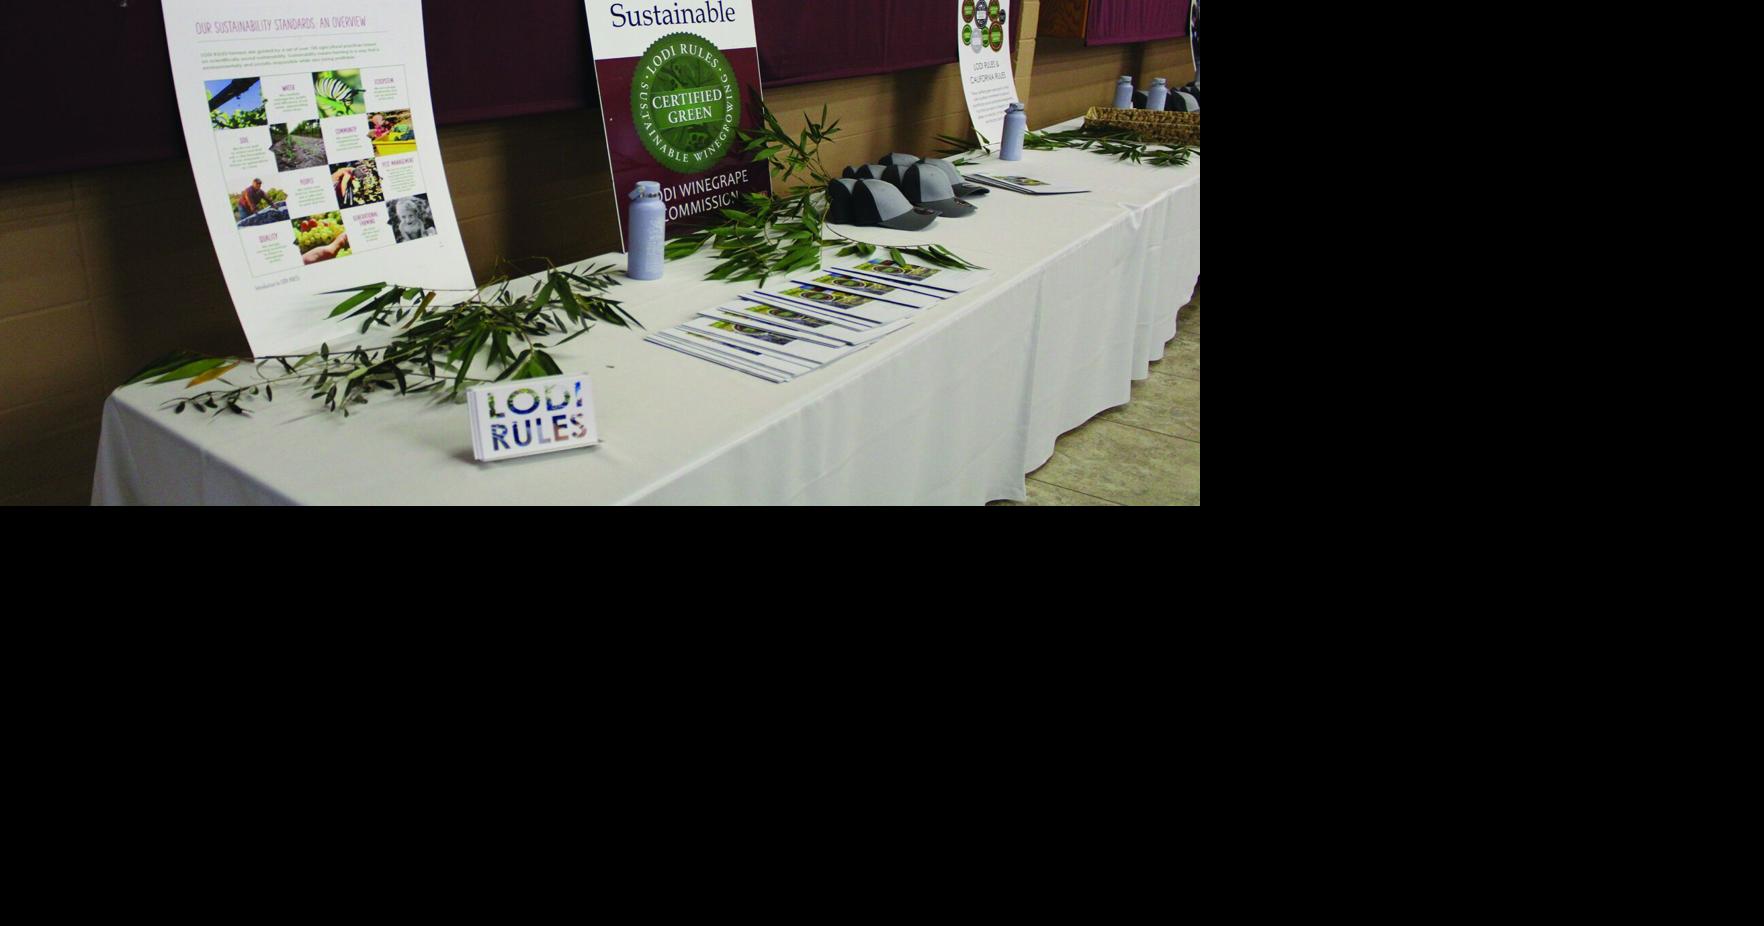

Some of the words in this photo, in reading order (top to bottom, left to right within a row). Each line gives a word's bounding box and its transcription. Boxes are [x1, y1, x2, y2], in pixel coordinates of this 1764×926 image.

[195, 21, 211, 35] OUR
[214, 19, 272, 34] SUSTAINABILITY
[319, 16, 330, 29] AN
[332, 15, 366, 28] OVERVIEW
[610, 0, 736, 27] Sustainable
[647, 45, 676, 75] LODI
[680, 43, 718, 68] RULES
[652, 88, 722, 109] CERTIFIED
[640, 82, 689, 163] SUSTAINABLE
[693, 73, 734, 162] WINEGROWING
[668, 105, 713, 124] GREEN
[679, 169, 749, 198] WINEGRAPE
[487, 381, 583, 419] LODI
[490, 413, 587, 451] RULES
